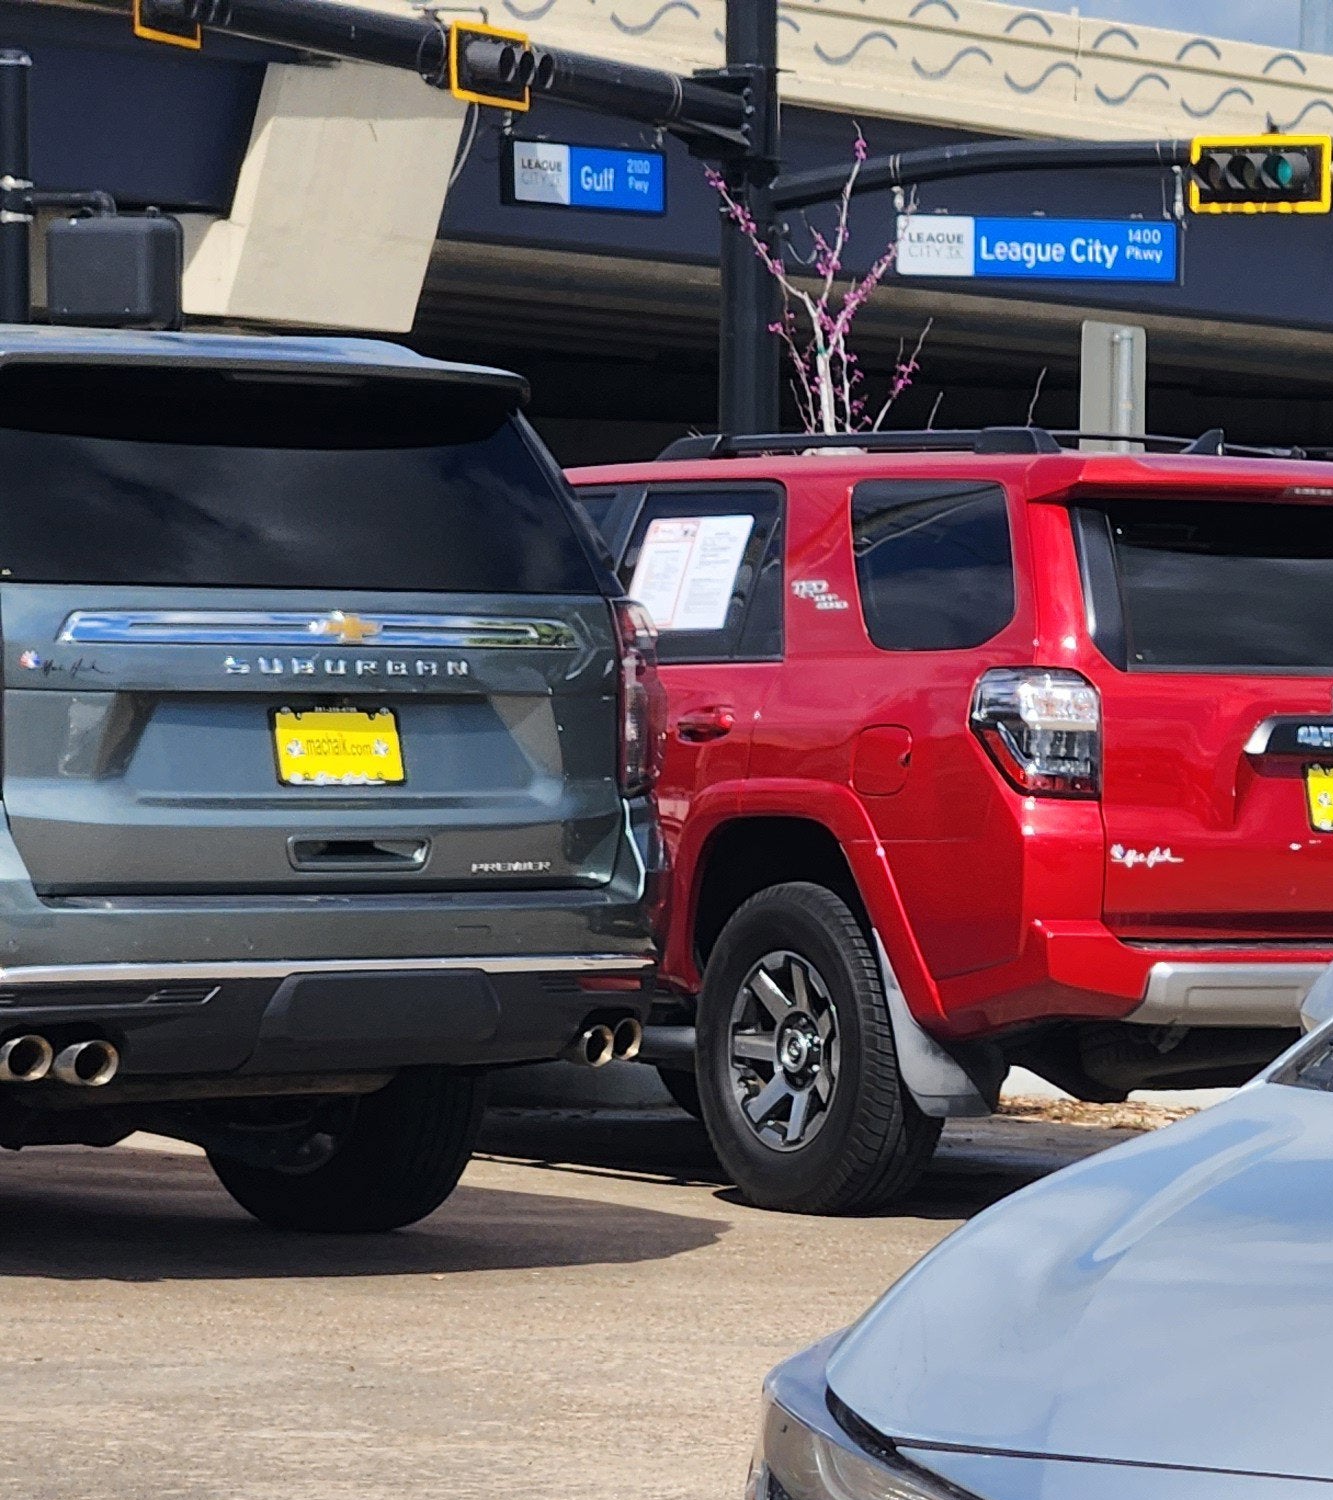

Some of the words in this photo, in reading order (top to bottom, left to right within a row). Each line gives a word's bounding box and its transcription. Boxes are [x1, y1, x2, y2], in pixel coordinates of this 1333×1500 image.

[521, 157, 562, 173] LEAGUE
[626, 158, 650, 174] 2100
[580, 165, 614, 192] Gulf
[628, 176, 650, 194] Fwy
[908, 231, 964, 245] LEAGUE
[1127, 228, 1162, 245] 1400
[908, 244, 942, 259] CITY
[980, 236, 1066, 269] League
[1070, 237, 1119, 270] City
[1125, 245, 1163, 265] Pkwy
[223, 656, 469, 676] SUBURBAN
[305, 732, 372, 757] machaik.com
[471, 861, 551, 873] PREMIER
